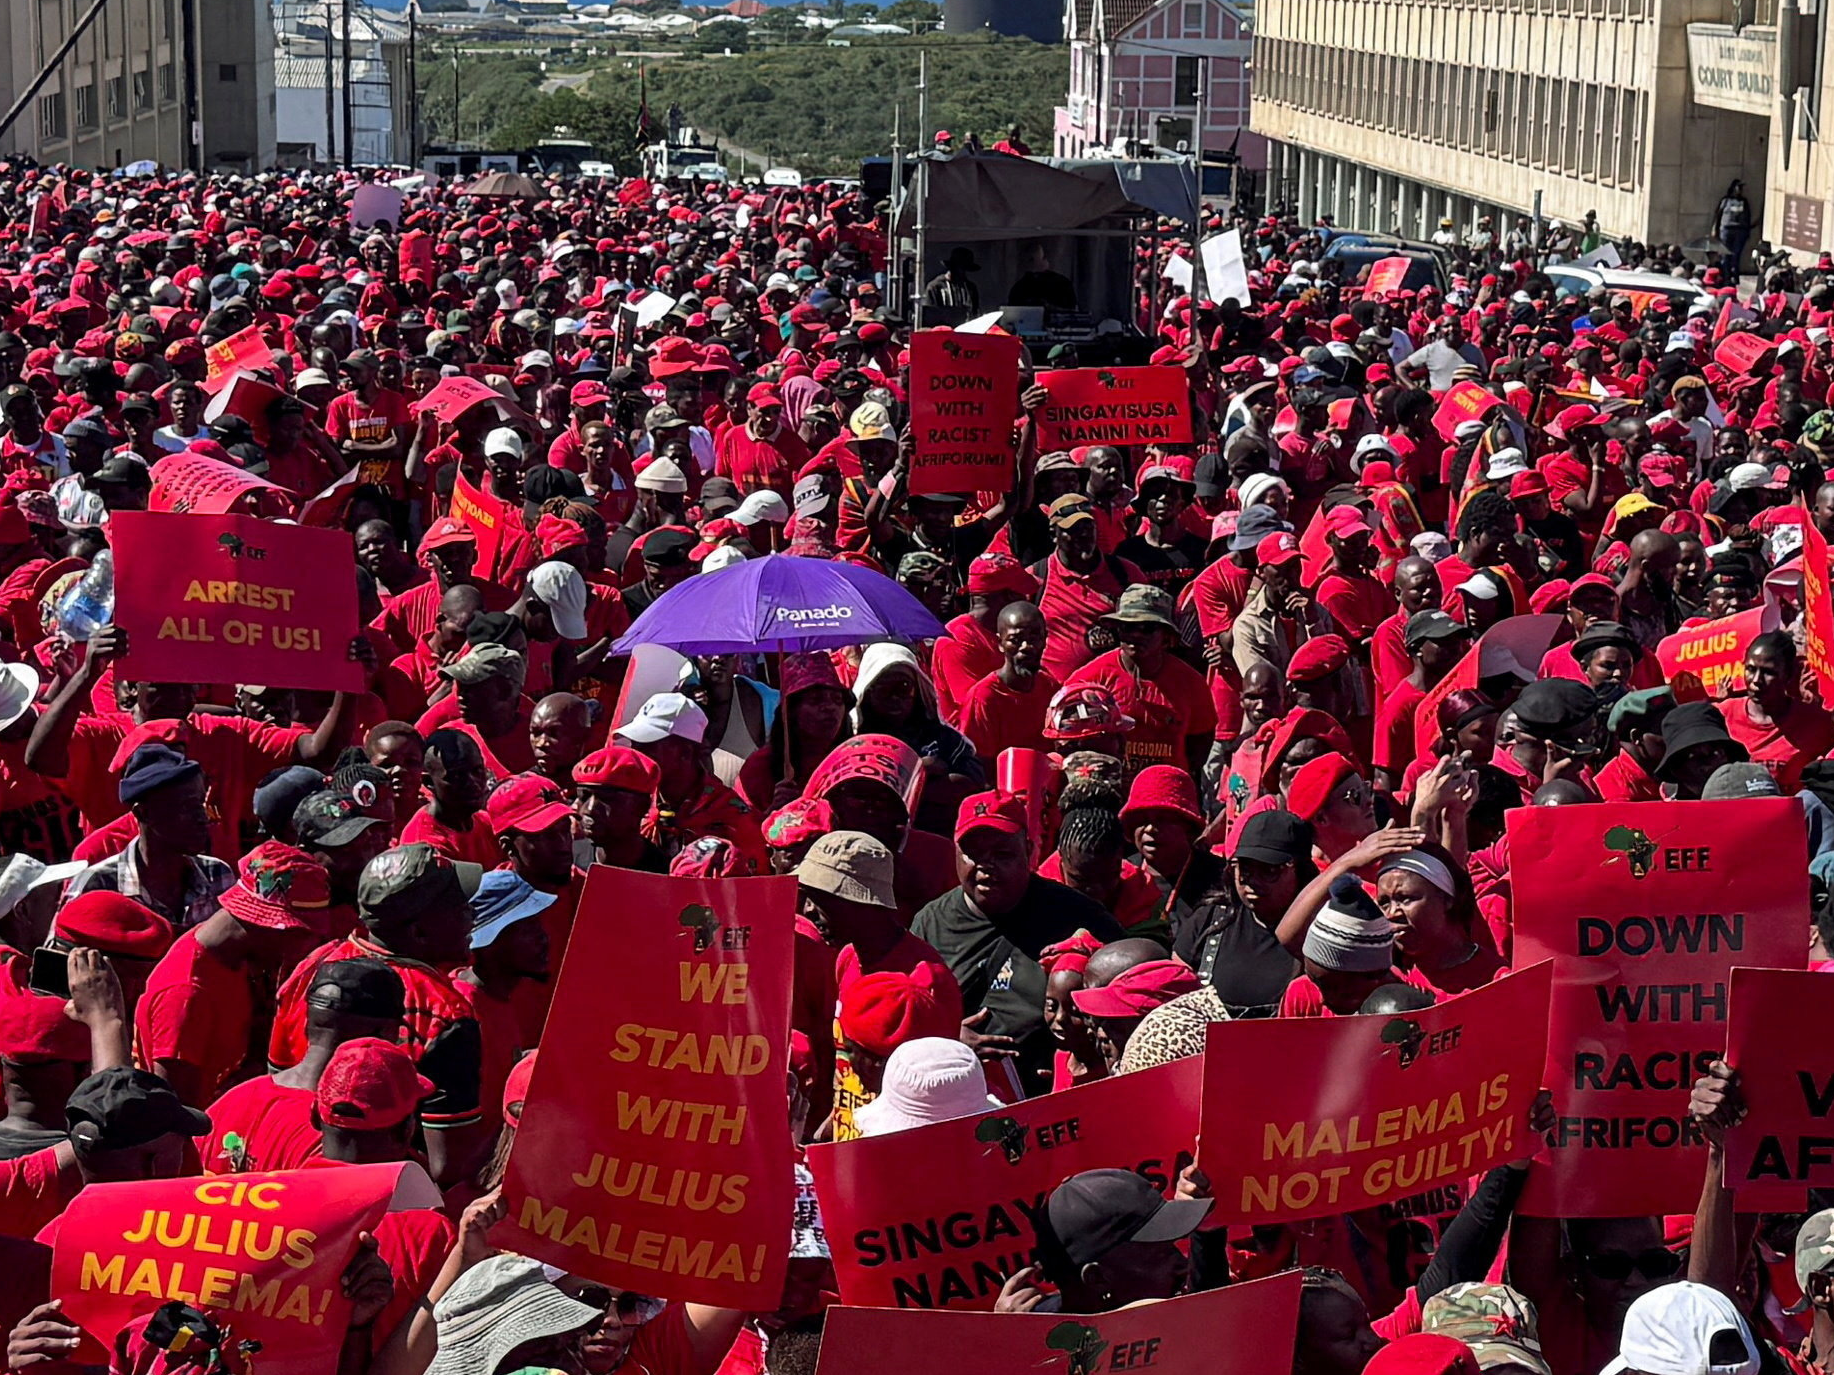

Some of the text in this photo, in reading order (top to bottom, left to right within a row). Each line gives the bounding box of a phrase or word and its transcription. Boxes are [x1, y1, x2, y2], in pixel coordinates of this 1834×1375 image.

[1698, 64, 1734, 91] COURT
[929, 375, 993, 392] DOWN
[934, 401, 984, 416] WITH
[1045, 404, 1179, 422] SINGAYISUSA
[927, 428, 991, 444] RACIST
[1058, 425, 1171, 442] NANINI NA!
[913, 453, 1006, 468] AFRIFORUM!
[183, 580, 296, 611] ARREST
[776, 603, 852, 621] Panado
[157, 616, 322, 651] ALL OF US!
[1675, 631, 1738, 663] JULIUS
[1125, 740, 1172, 758] REGIONAL
[1665, 846, 1712, 872] EFF
[722, 926, 751, 949] EFF
[1576, 913, 1745, 957] DOWN
[679, 961, 749, 1004] WE
[1594, 981, 1727, 1024] WITH
[608, 1023, 770, 1075] STAND
[1428, 1025, 1464, 1057] EFF
[616, 1091, 747, 1145] WITH
[1262, 1072, 1511, 1162] MALEMA IS
[1039, 1117, 1081, 1150] EFF
[1240, 1114, 1515, 1214] NOT GUILTY!
[194, 1181, 287, 1210] CIC
[572, 1153, 749, 1214] JULIUS
[122, 1209, 317, 1269] JULIUS
[518, 1196, 767, 1283] MALEMA!
[79, 1251, 333, 1325] MALEMA!
[1110, 1336, 1161, 1371] EFF
